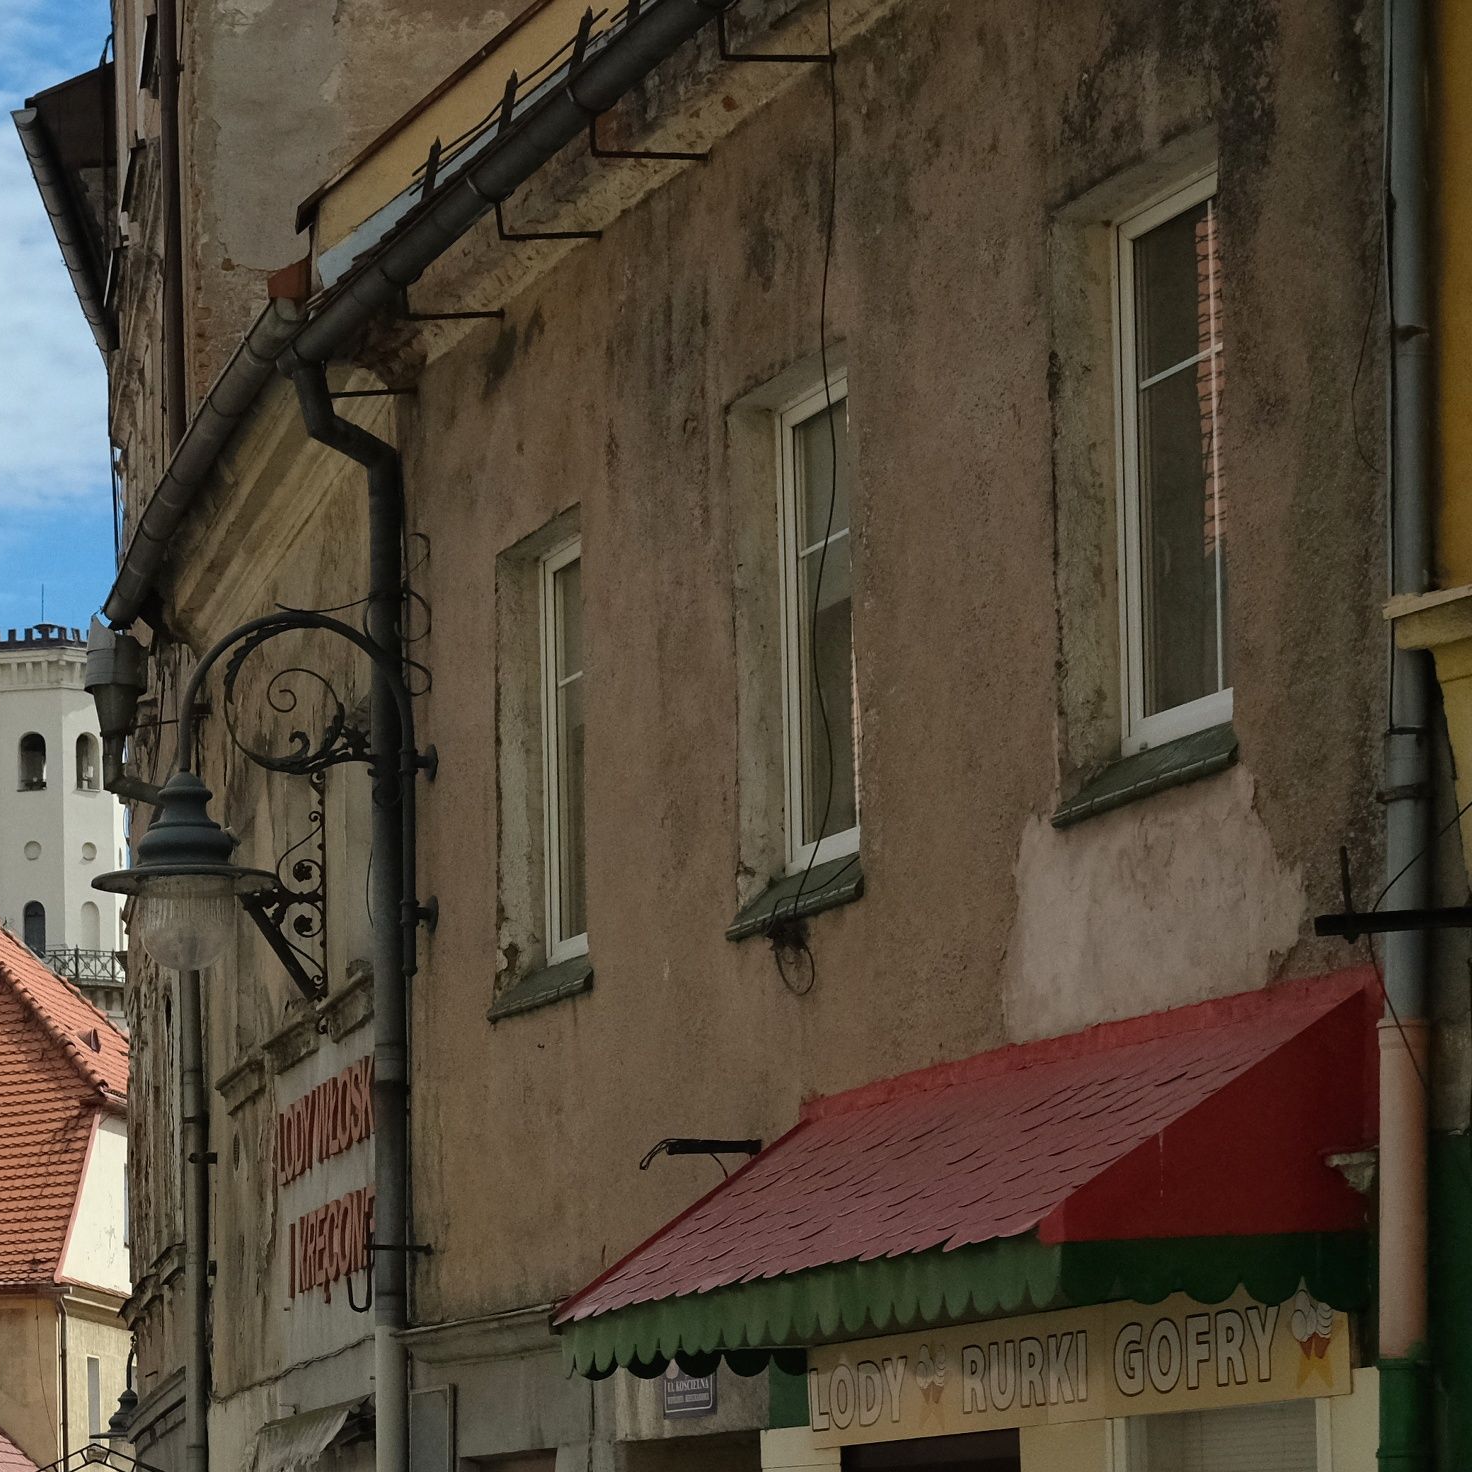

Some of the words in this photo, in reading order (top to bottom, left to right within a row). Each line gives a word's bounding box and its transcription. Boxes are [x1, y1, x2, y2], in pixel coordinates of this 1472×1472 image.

[277, 1088, 317, 1187] LODY
[315, 1055, 375, 1164] WŁOSK
[288, 1222, 297, 1299] I
[809, 1354, 908, 1432] LODY
[961, 1330, 1089, 1415] RURKI
[1112, 1304, 1280, 1398] GOFRY
